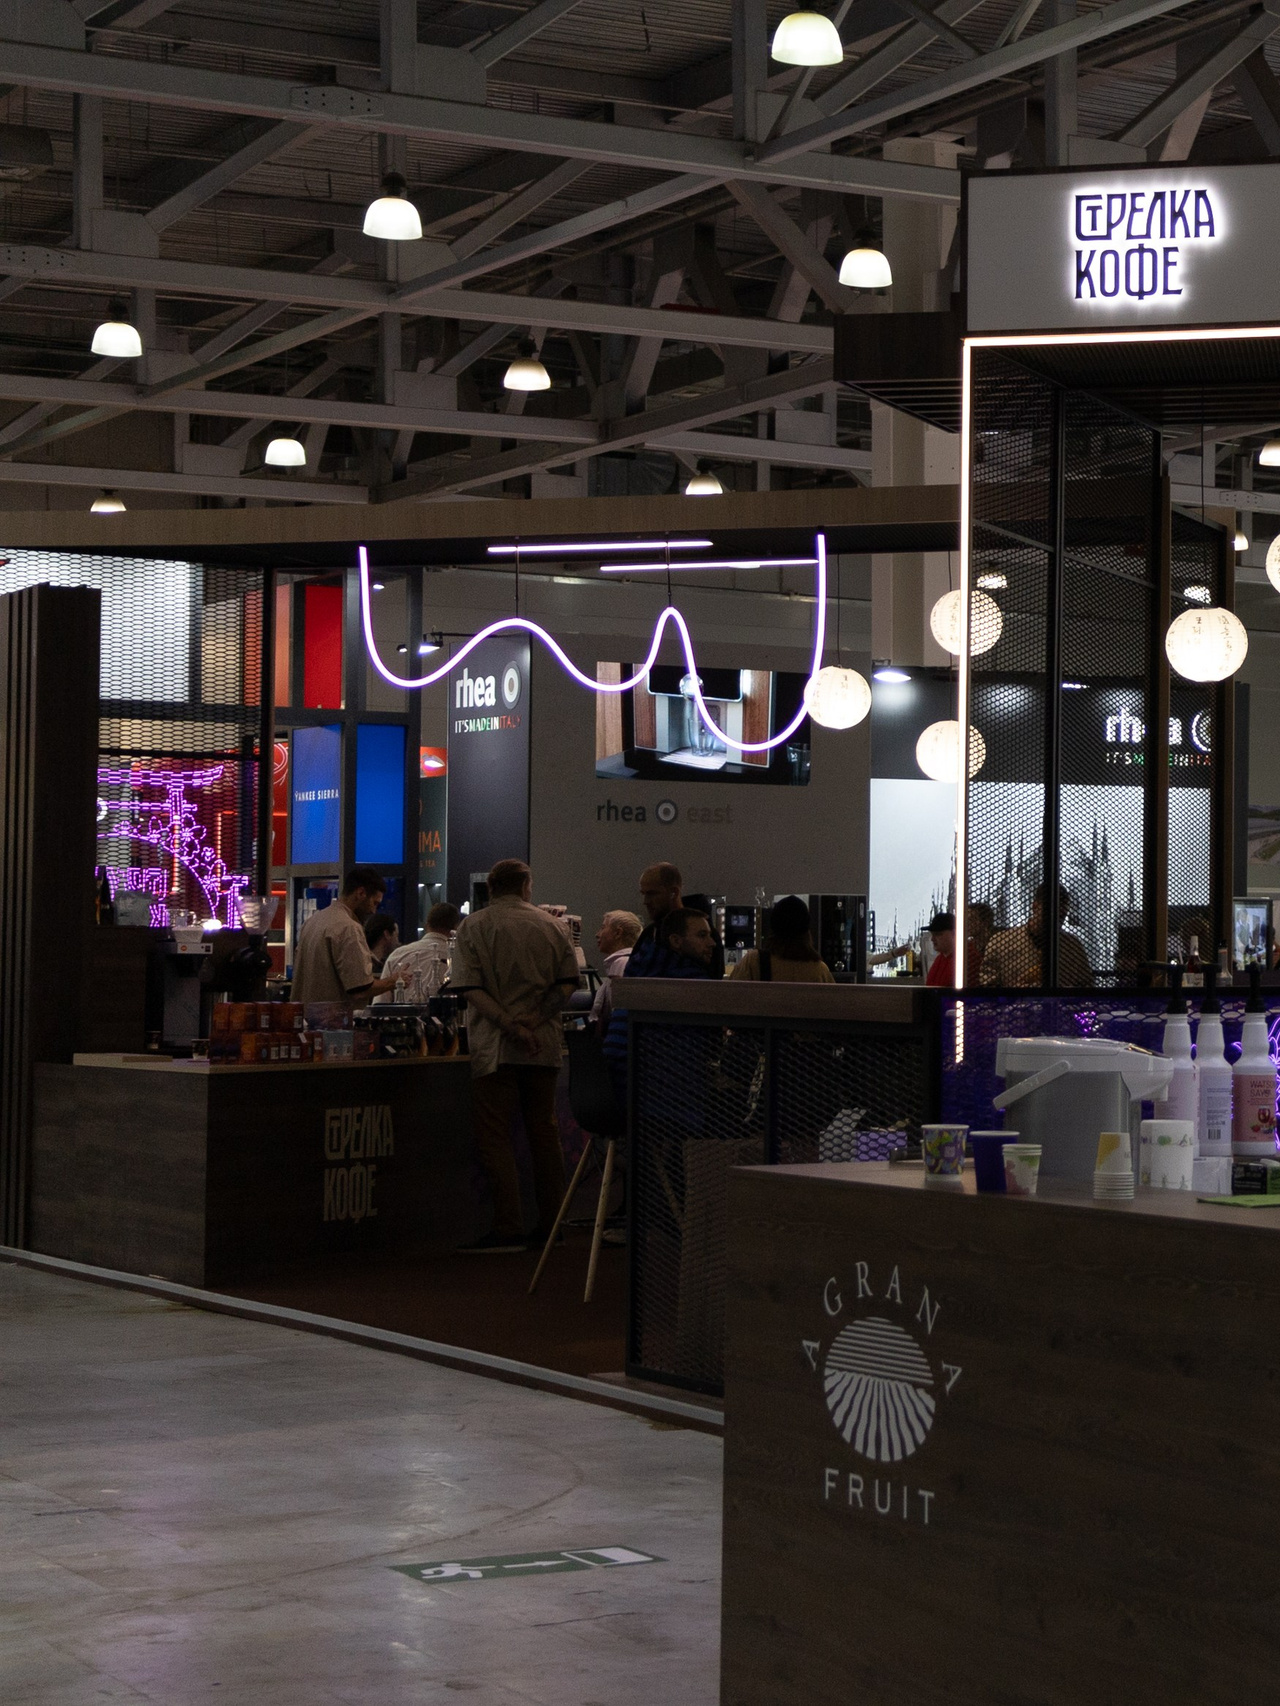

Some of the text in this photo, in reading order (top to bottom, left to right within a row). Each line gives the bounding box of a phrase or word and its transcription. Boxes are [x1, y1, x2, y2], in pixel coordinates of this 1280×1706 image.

[1074, 243, 1183, 300] КОФЕ
[455, 667, 497, 708] rhea
[1106, 706, 1182, 745] rha
[317, 788, 339, 800] SIERRA
[596, 799, 734, 824] rhea east
[323, 1162, 378, 1224] КОФЕ
[824, 1467, 935, 1525] FRUIT
